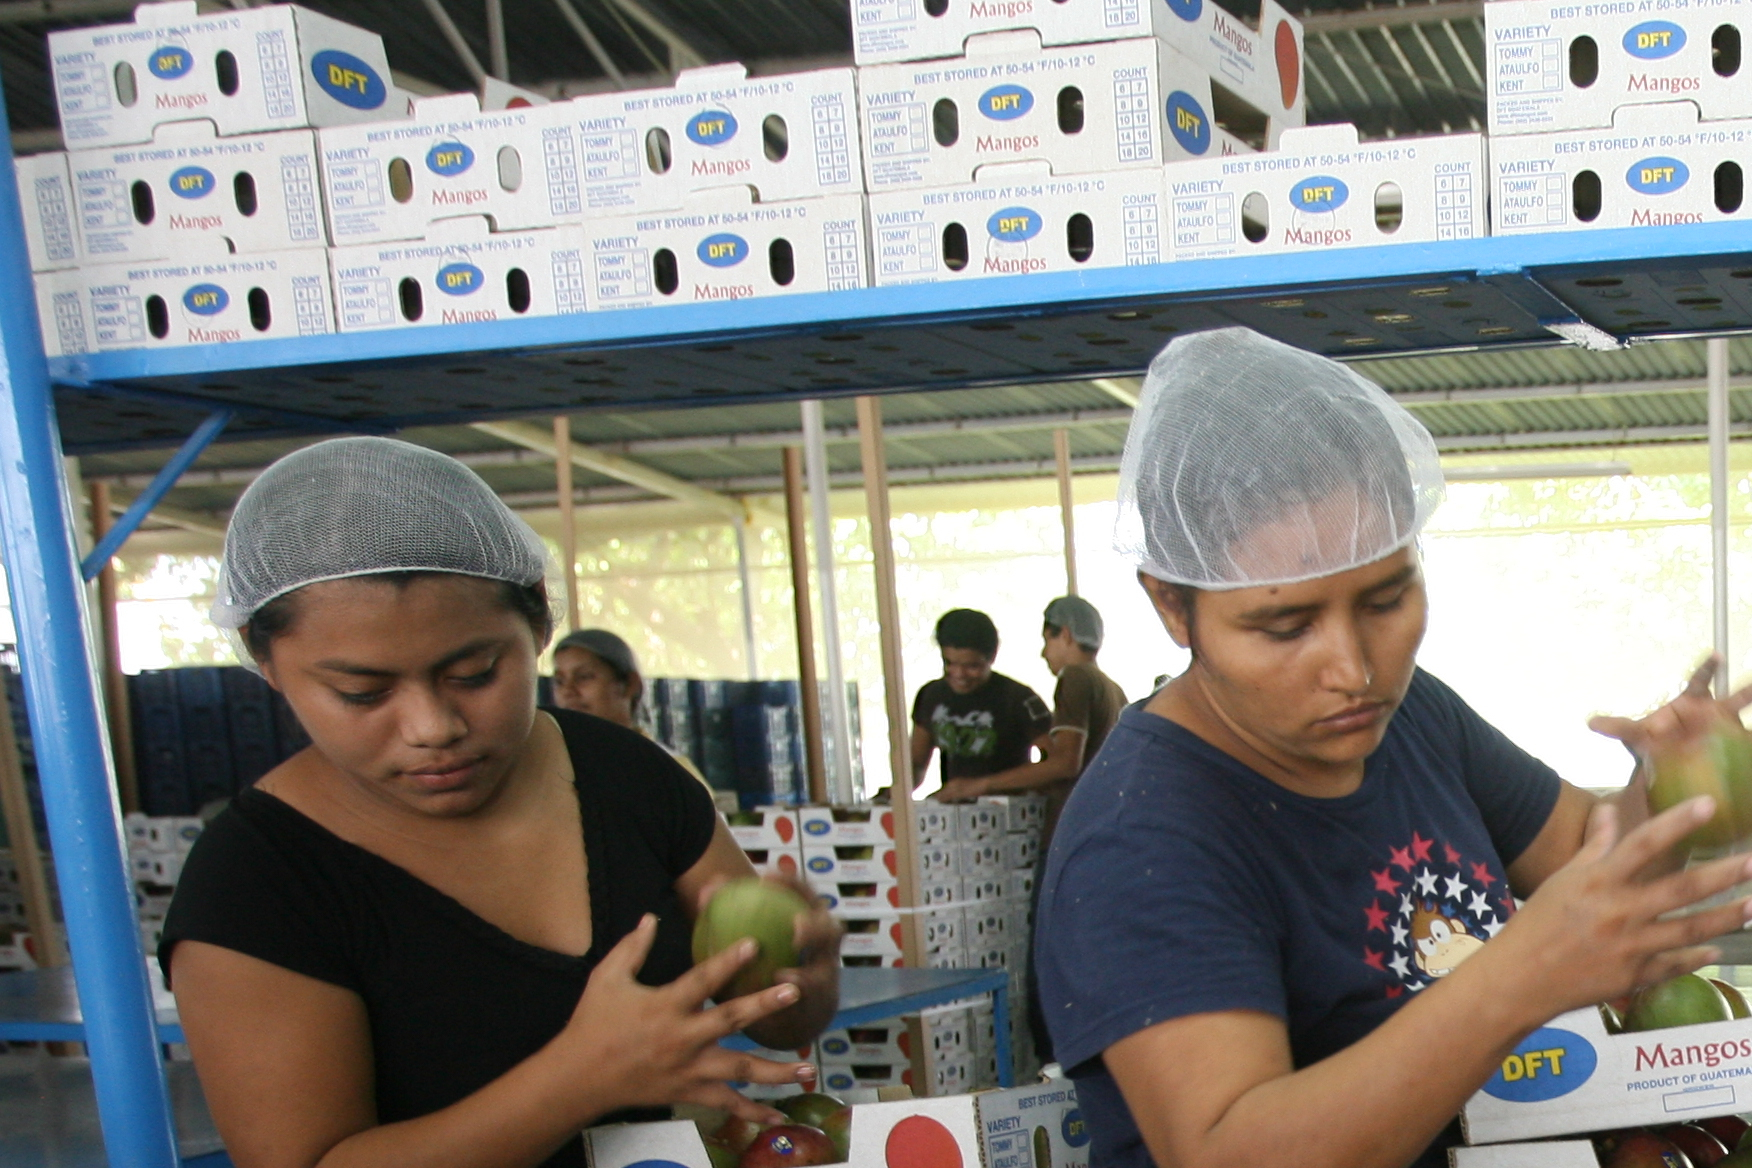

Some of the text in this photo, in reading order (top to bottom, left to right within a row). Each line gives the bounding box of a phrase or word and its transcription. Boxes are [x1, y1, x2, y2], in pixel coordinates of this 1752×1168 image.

[970, 1, 1033, 19] Mangos
[1214, 11, 1253, 56] Mangos
[1638, 31, 1672, 48] DFT
[158, 54, 182, 70] DFT
[327, 64, 368, 94] DFT
[1112, 67, 1147, 79] COUNT
[1627, 75, 1701, 95] Mangos
[157, 94, 209, 110] Mangos
[866, 90, 916, 104] VARIETY
[991, 94, 1020, 110] DFT
[579, 117, 626, 132] VARIETY
[1176, 106, 1202, 131] DFT
[697, 120, 724, 136] DFT
[977, 135, 1040, 153] Mangos
[326, 148, 369, 162] VARIETY
[437, 152, 462, 167] DFT
[692, 160, 752, 177] Mangos
[1434, 161, 1471, 174] COUNT
[1642, 167, 1675, 184] DFT
[179, 175, 203, 190] DFT
[1172, 181, 1224, 195] VARIETY
[433, 190, 489, 206] Mangos
[1303, 186, 1333, 203] DFT
[170, 216, 224, 231] Mangos
[999, 217, 1028, 233] DFT
[1285, 229, 1352, 246] Mangos
[709, 243, 735, 258] DFT
[984, 257, 1047, 275] Mangos
[446, 271, 471, 286] DFT
[193, 292, 217, 307] DFT
[695, 285, 755, 300] Mangos
[442, 309, 498, 324] Mangos
[189, 329, 241, 343] Mangos
[1635, 1038, 1752, 1071] Mangos
[1501, 1048, 1565, 1082] DFT
[1626, 1076, 1679, 1091] PRODUCT
[1681, 1074, 1697, 1085] OF
[987, 1116, 1021, 1133] VARIETY
